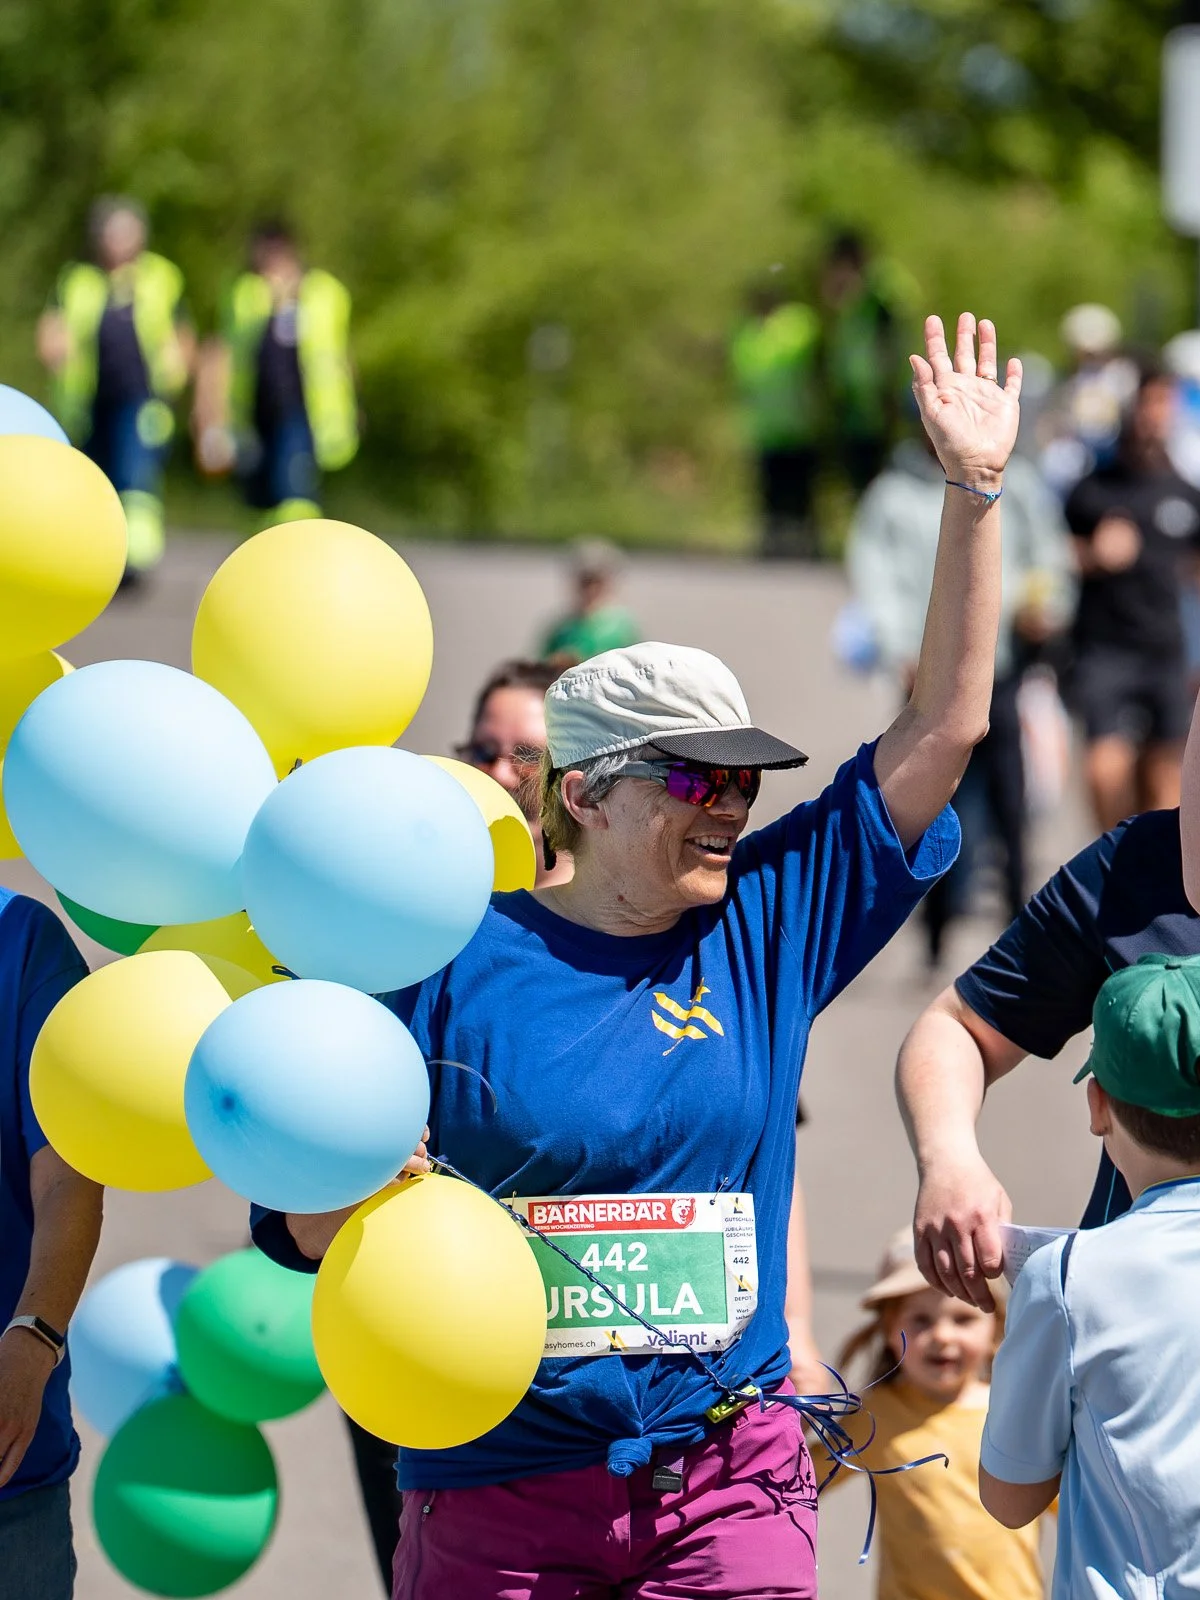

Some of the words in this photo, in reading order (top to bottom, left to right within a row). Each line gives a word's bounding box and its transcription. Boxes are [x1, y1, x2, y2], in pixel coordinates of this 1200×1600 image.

[533, 1202, 667, 1225] BÄRNERBÄR
[580, 1241, 649, 1273] 442
[733, 1256, 750, 1264] 442
[544, 1340, 596, 1351] asyhomes.ch
[647, 1330, 708, 1347] valiant
